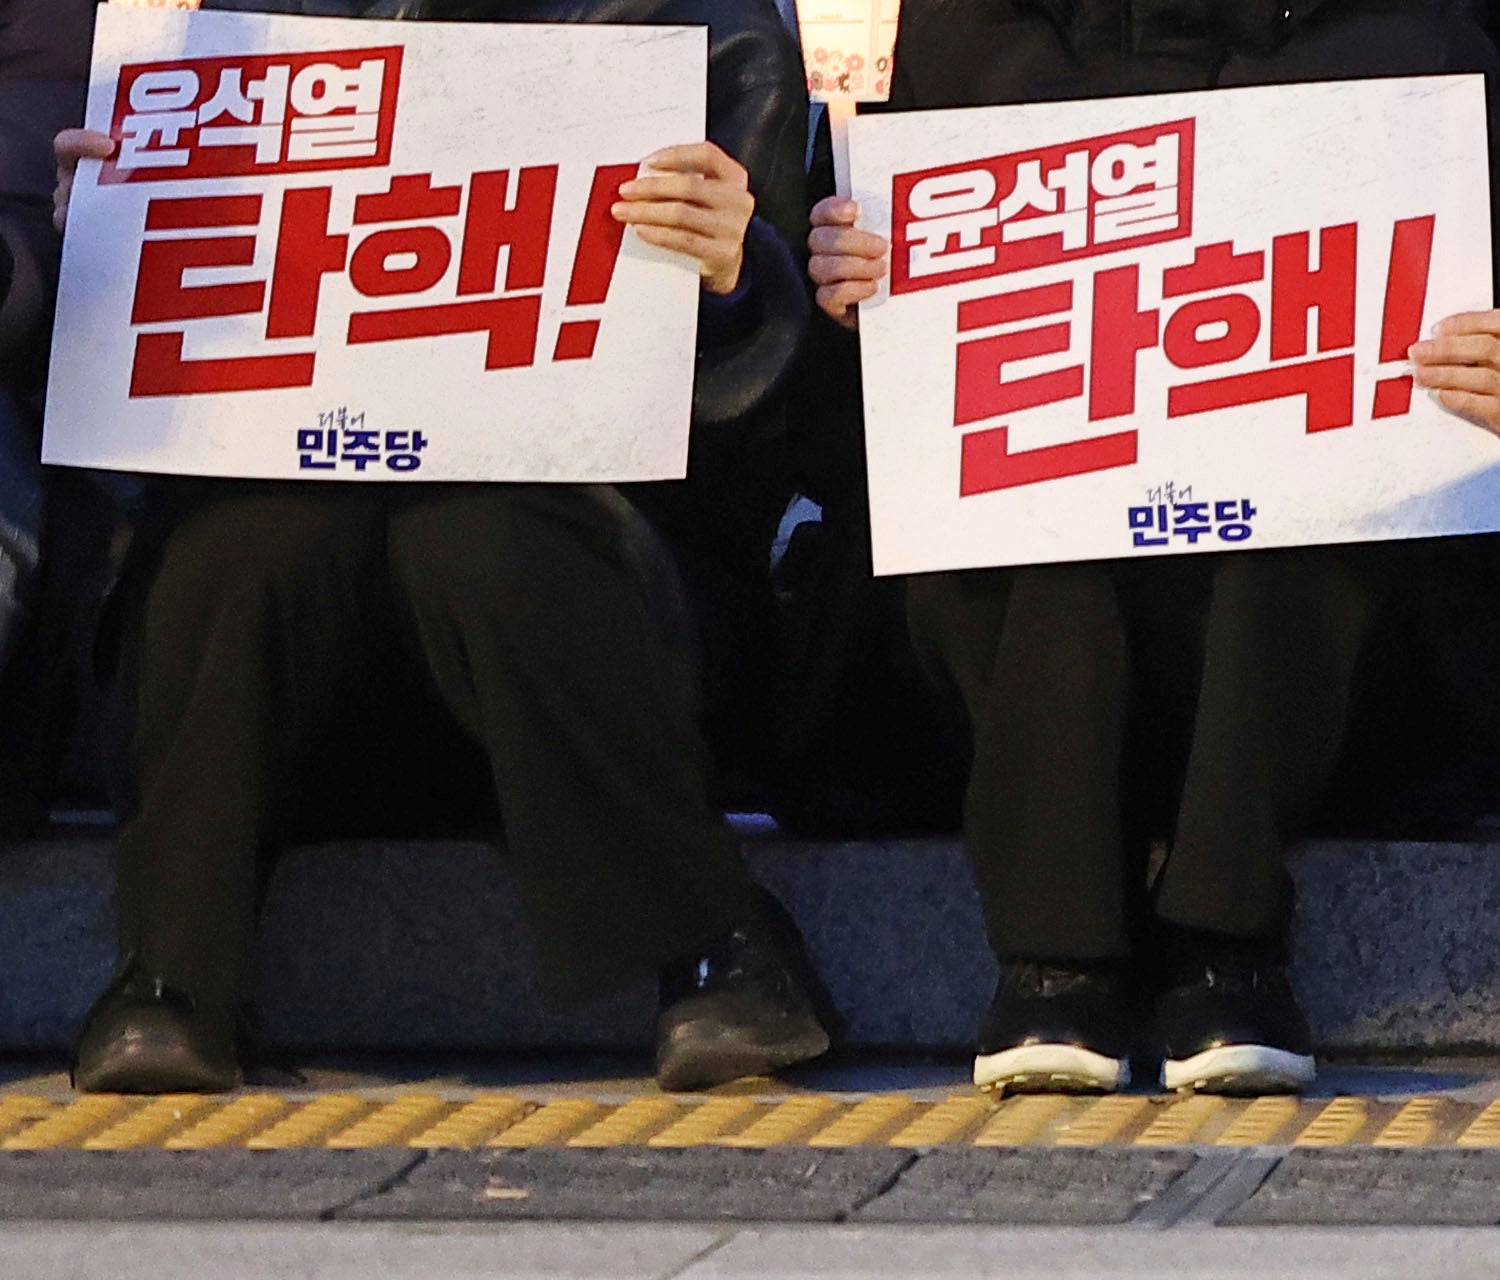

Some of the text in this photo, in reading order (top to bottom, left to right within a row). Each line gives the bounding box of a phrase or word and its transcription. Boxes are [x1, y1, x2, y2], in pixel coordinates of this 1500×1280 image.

[117, 60, 384, 170] 윤석열
[907, 135, 1179, 278] 윤석열
[129, 163, 641, 398] 탄핵!
[954, 215, 1436, 498] 탄핵!
[297, 429, 427, 472] 민주당
[316, 408, 366, 429] 더불어
[1128, 501, 1257, 548] 민주당
[1147, 483, 1194, 504] 더불어
